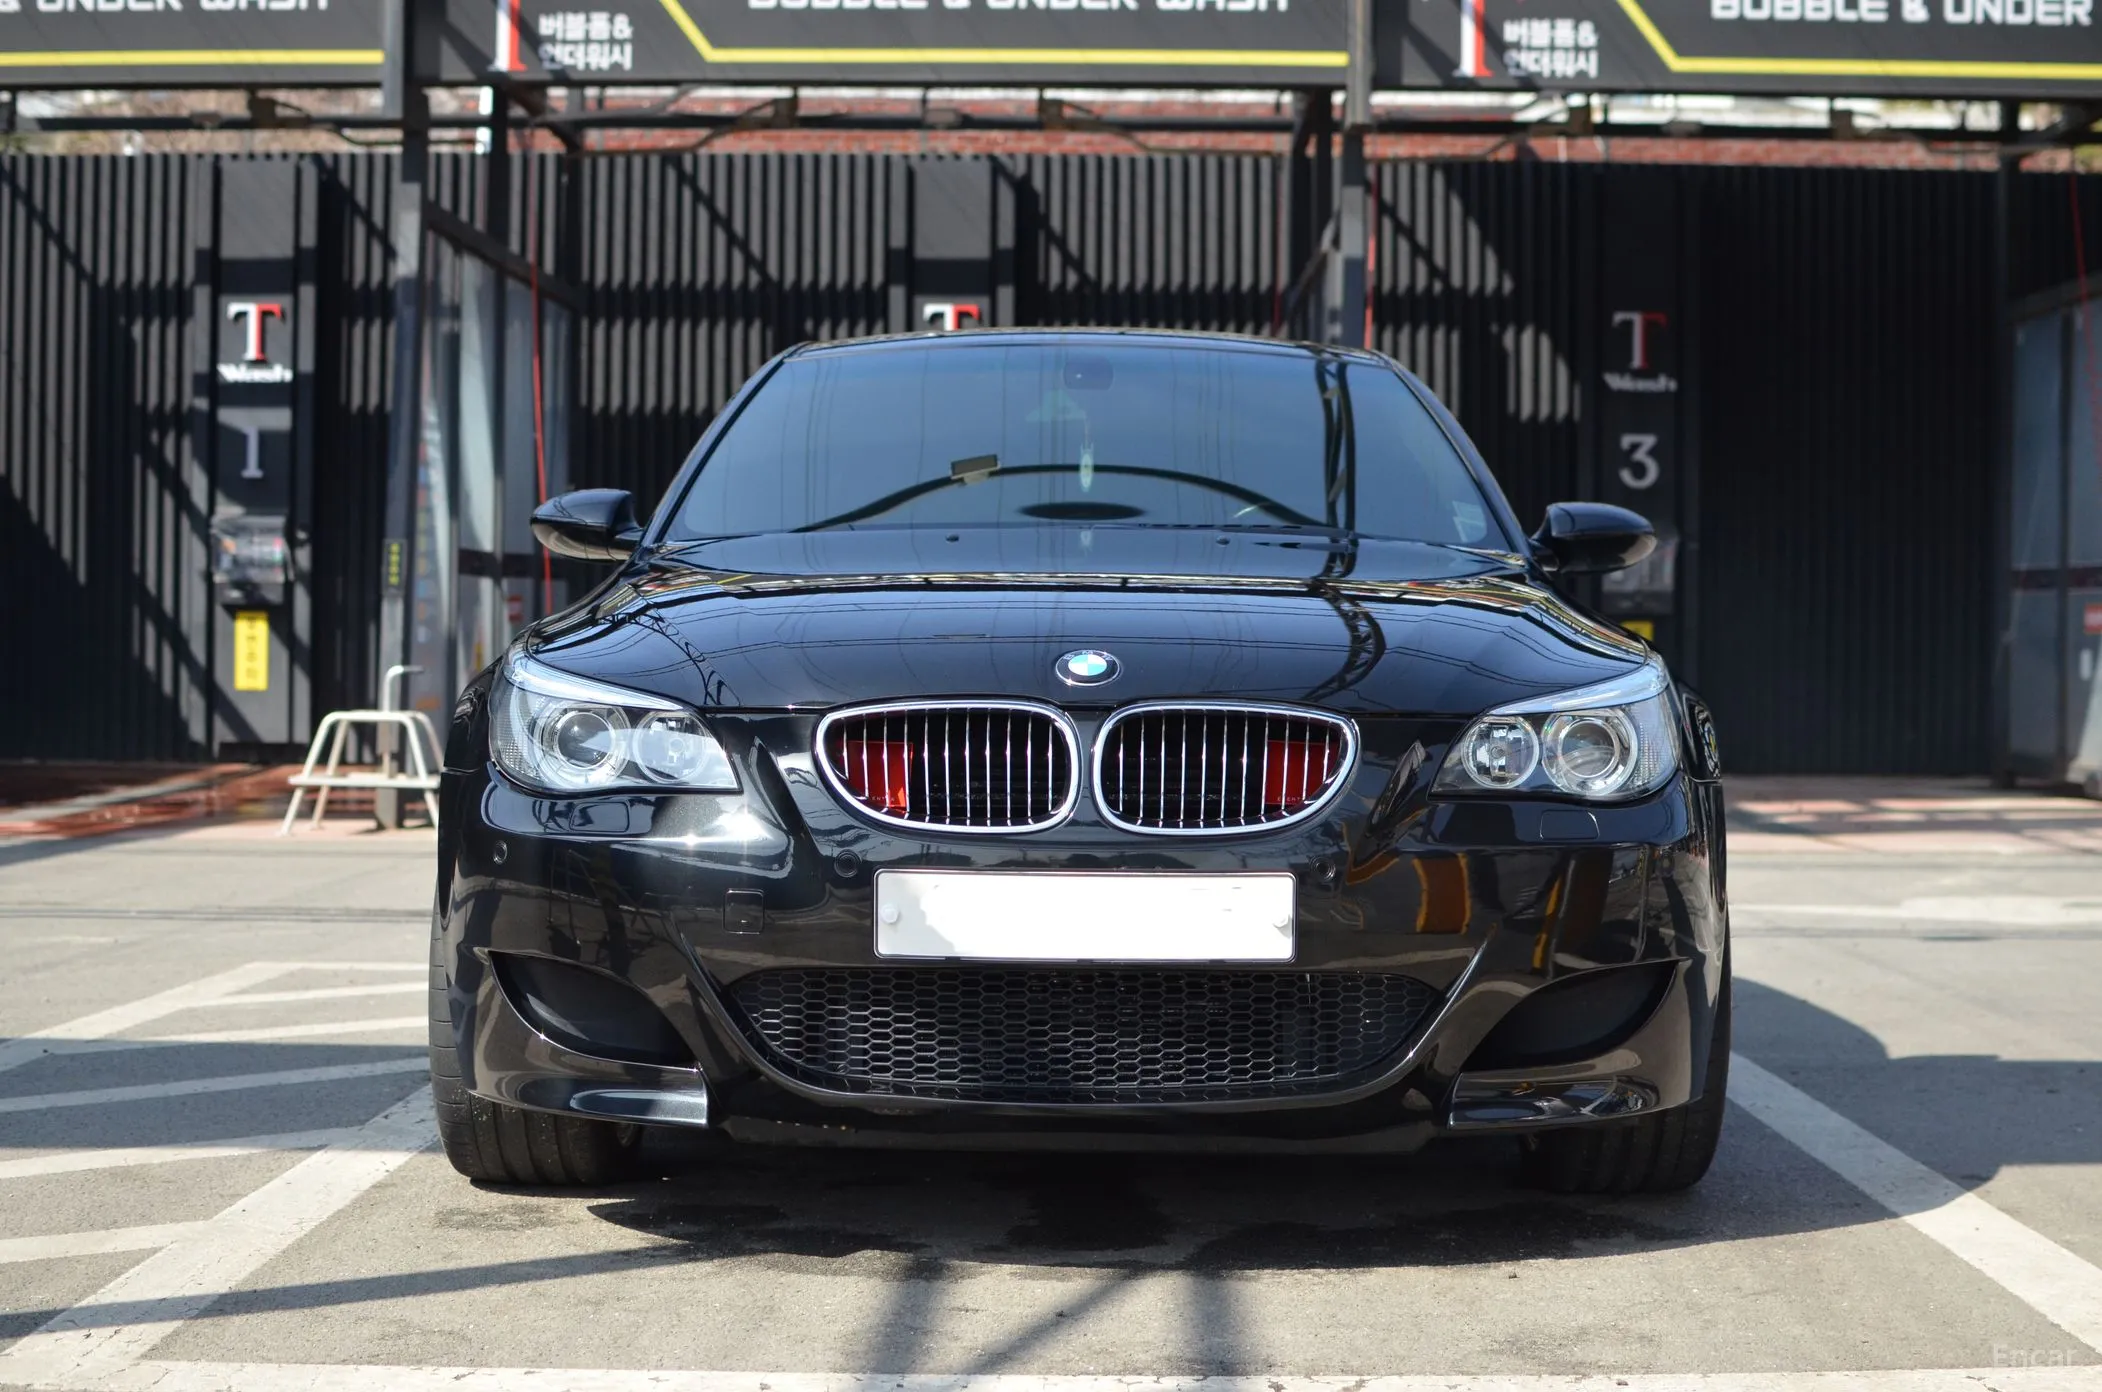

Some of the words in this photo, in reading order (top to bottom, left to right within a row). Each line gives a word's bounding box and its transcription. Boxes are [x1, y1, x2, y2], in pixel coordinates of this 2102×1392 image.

[1943, 0, 2094, 27] UNDER
[227, 302, 283, 362] T
[1612, 311, 1668, 369] T
[1619, 433, 1660, 489] 3
